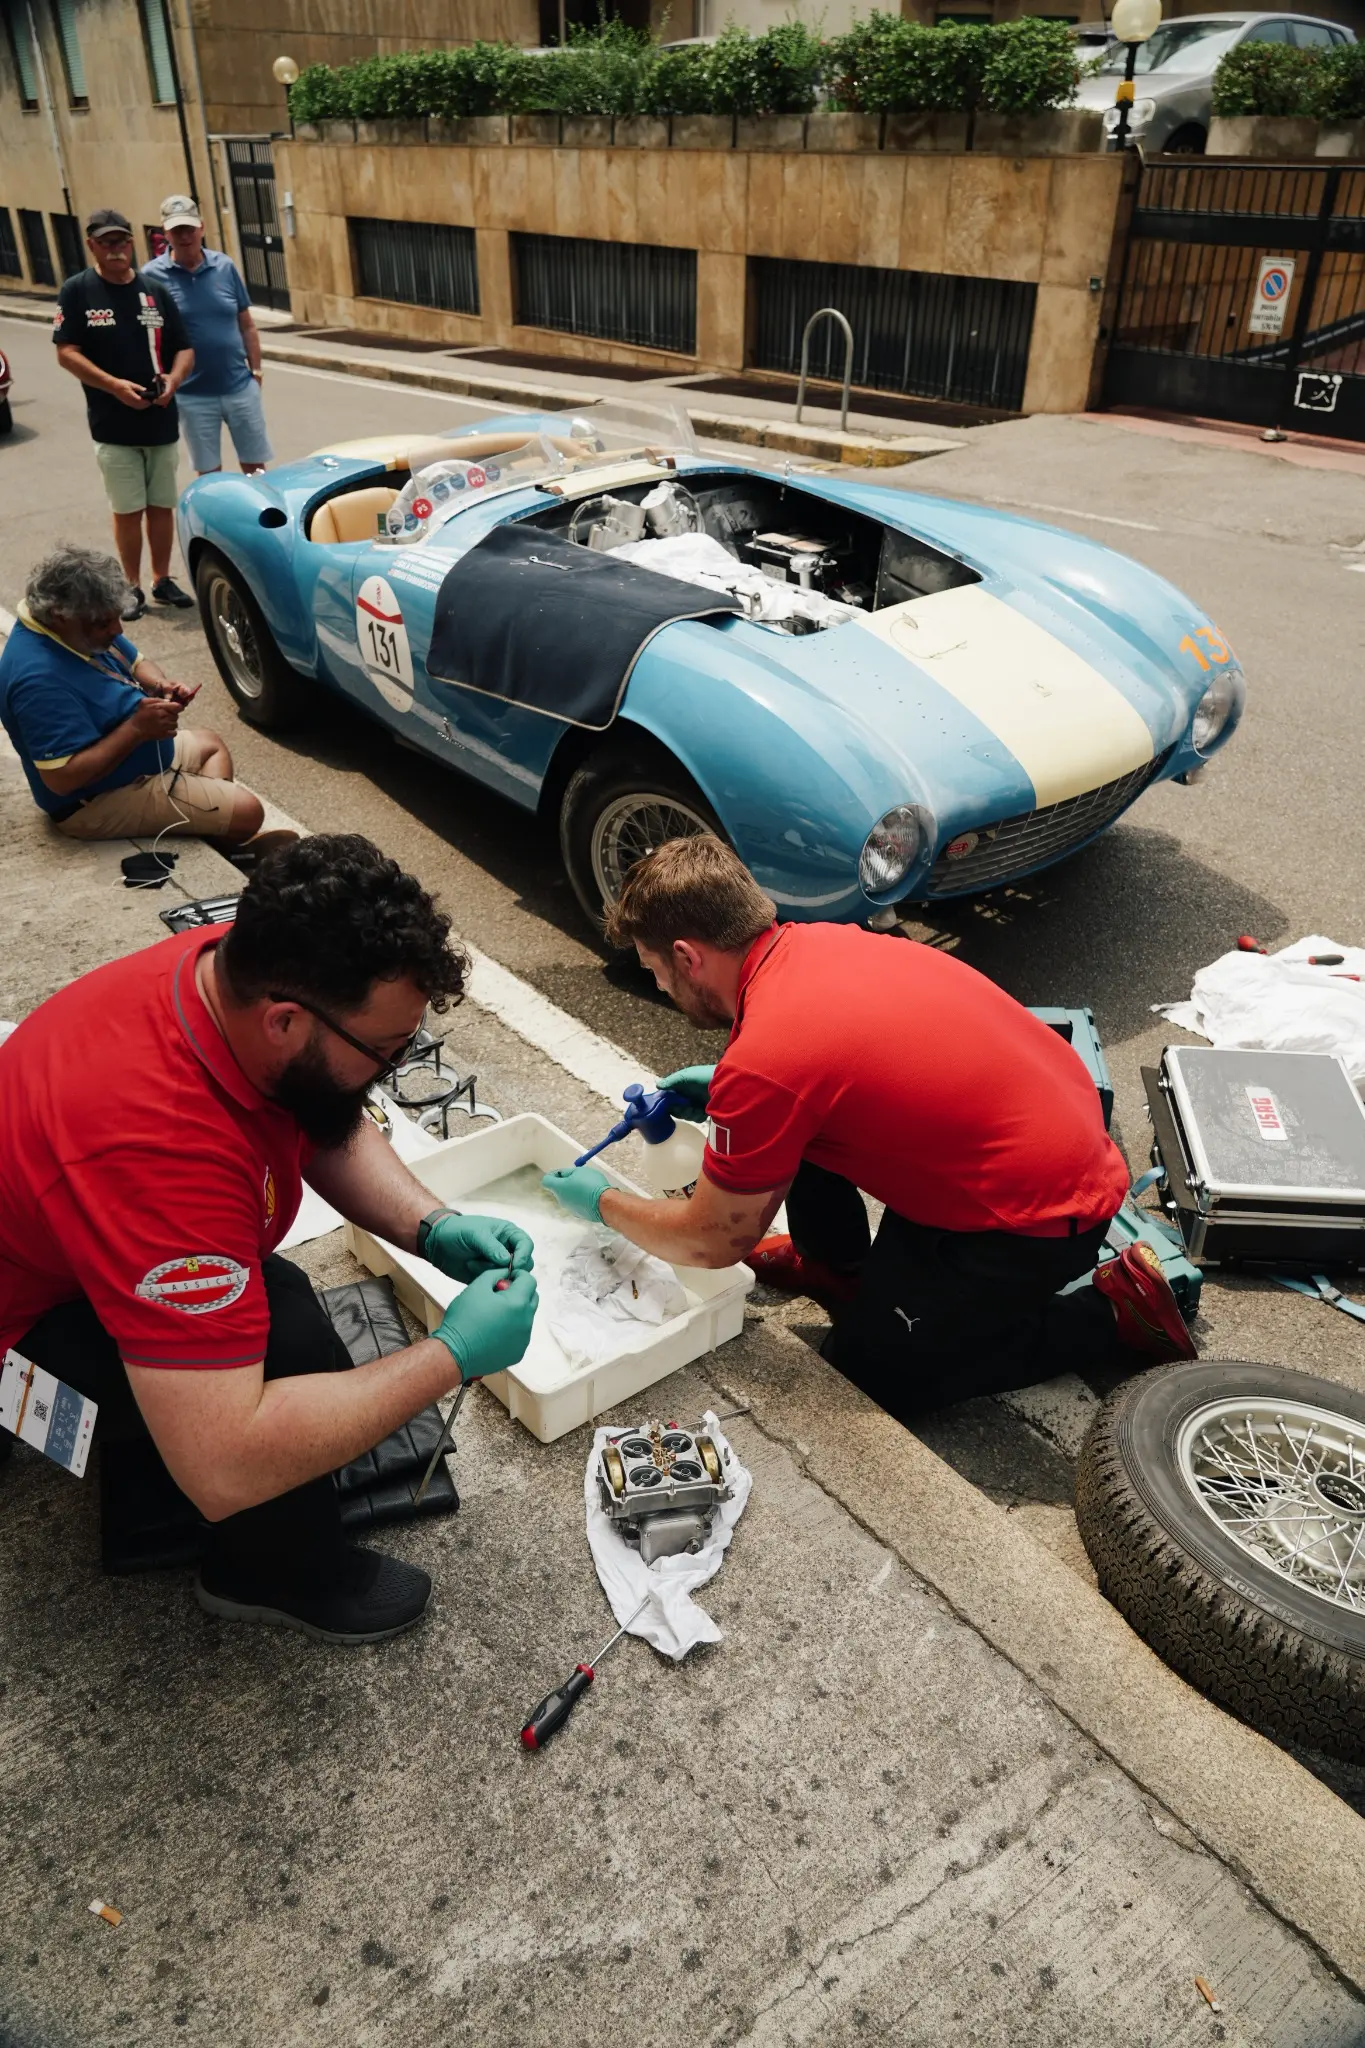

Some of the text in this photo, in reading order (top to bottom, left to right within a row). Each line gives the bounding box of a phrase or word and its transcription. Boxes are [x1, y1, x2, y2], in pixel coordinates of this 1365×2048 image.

[85, 308, 114, 319] 1000
[368, 621, 400, 674] 131
[1179, 626, 1240, 672] 13
[1251, 1098, 1280, 1128] USAG
[149, 1273, 241, 1294] CLASSICHE
